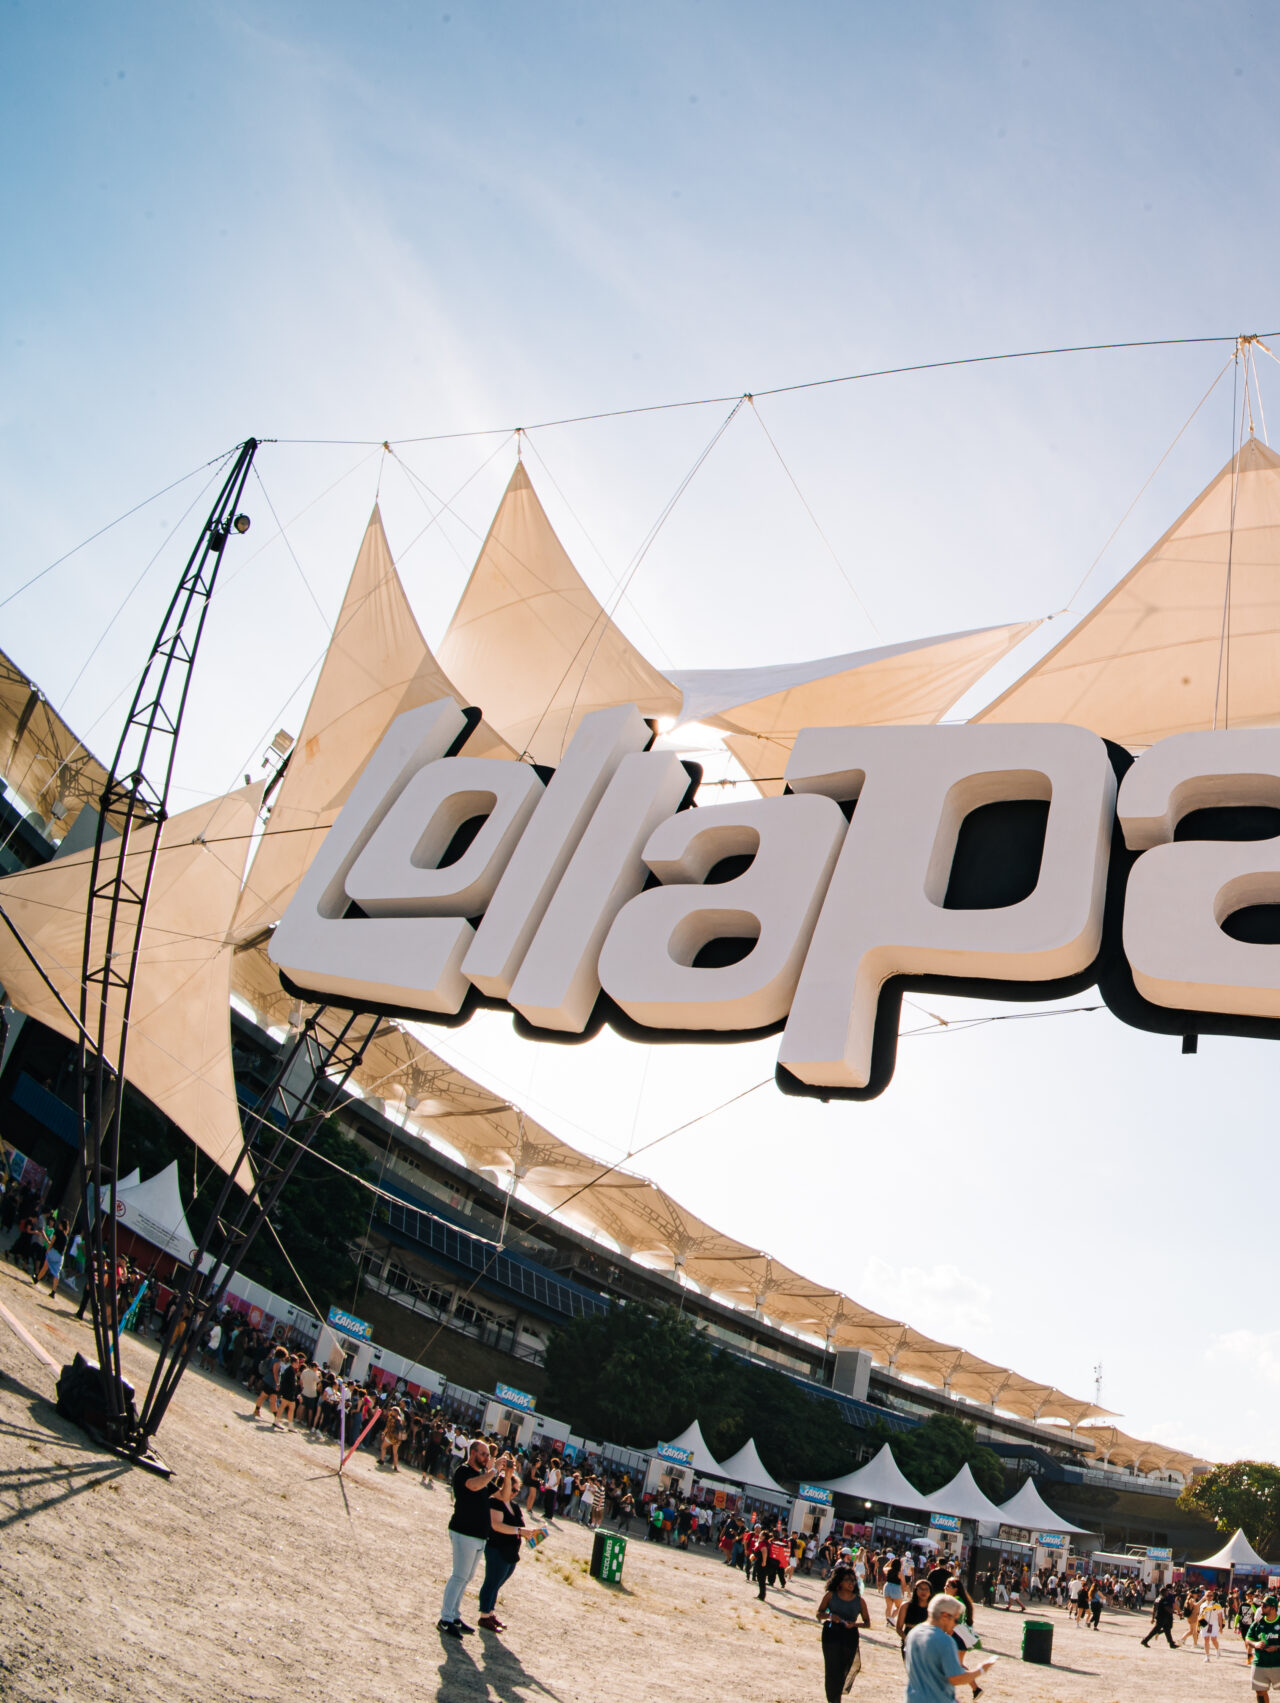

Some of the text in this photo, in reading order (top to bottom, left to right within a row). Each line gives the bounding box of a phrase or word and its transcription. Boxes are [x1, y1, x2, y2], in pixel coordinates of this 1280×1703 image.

[335, 1314, 366, 1335] CAIXAS
[501, 1390, 529, 1407] CAIXAS
[662, 1447, 688, 1462] CAIXAS
[804, 1488, 828, 1501] CAIXAS
[935, 1517, 956, 1528] CAIXAS
[1042, 1536, 1061, 1545] CAIXAS
